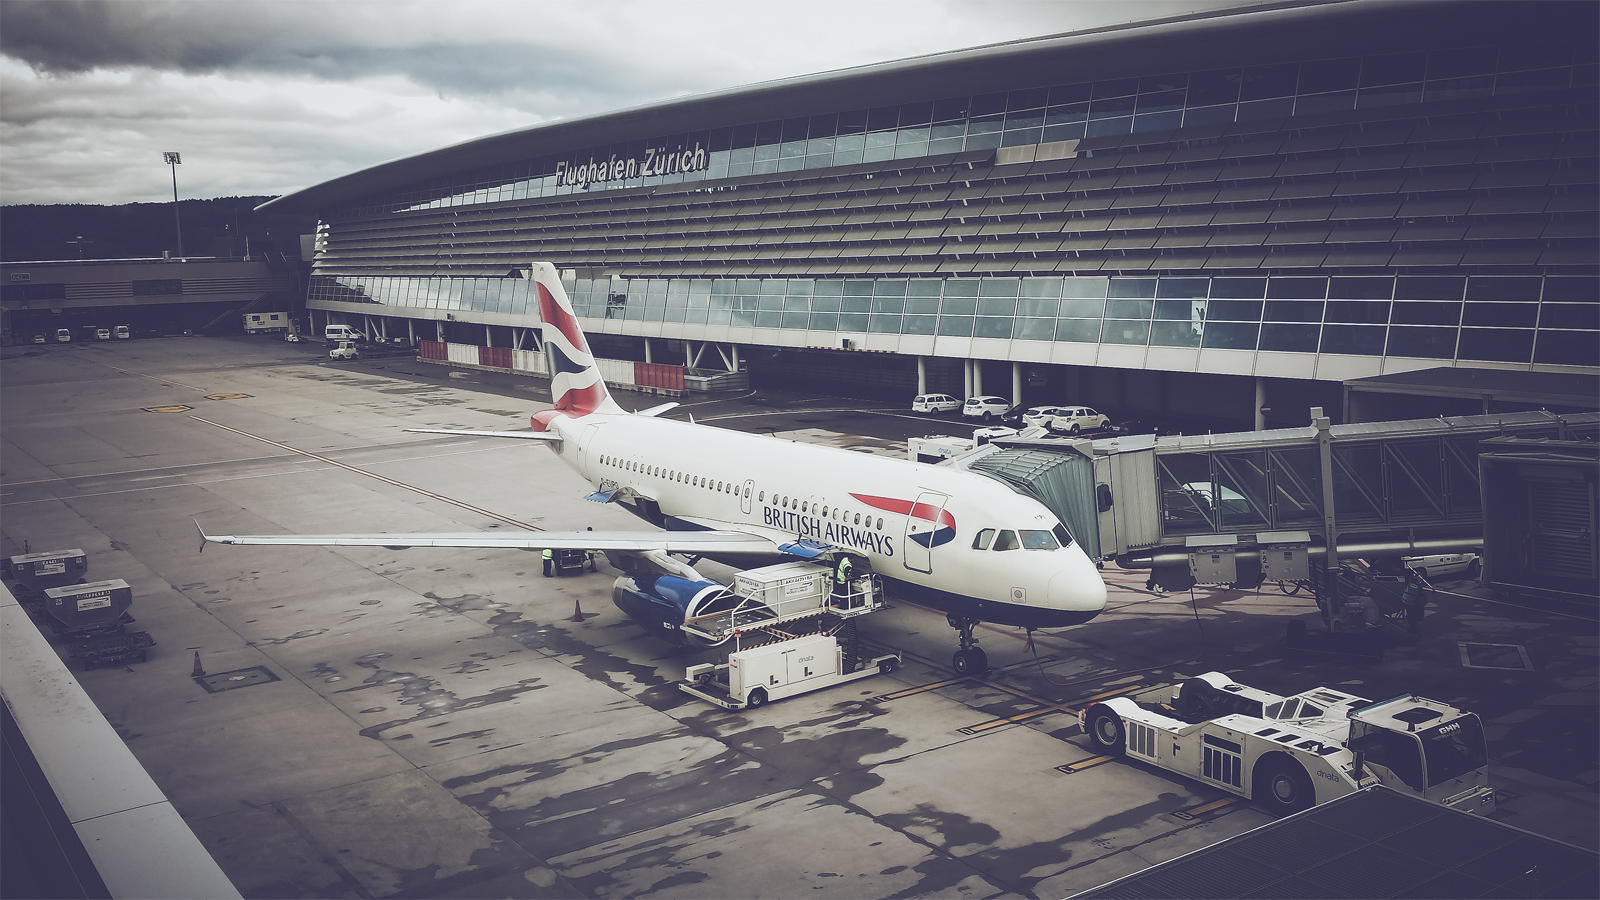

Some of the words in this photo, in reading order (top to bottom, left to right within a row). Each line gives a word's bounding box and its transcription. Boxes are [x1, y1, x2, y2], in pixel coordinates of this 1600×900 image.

[555, 154, 636, 189] Flughafen
[642, 142, 705, 176] Zürich
[763, 506, 821, 538] BRITISH
[824, 521, 894, 557] AIRWAYS
[1438, 722, 1461, 734] GHH
[1316, 769, 1340, 783] dnata
